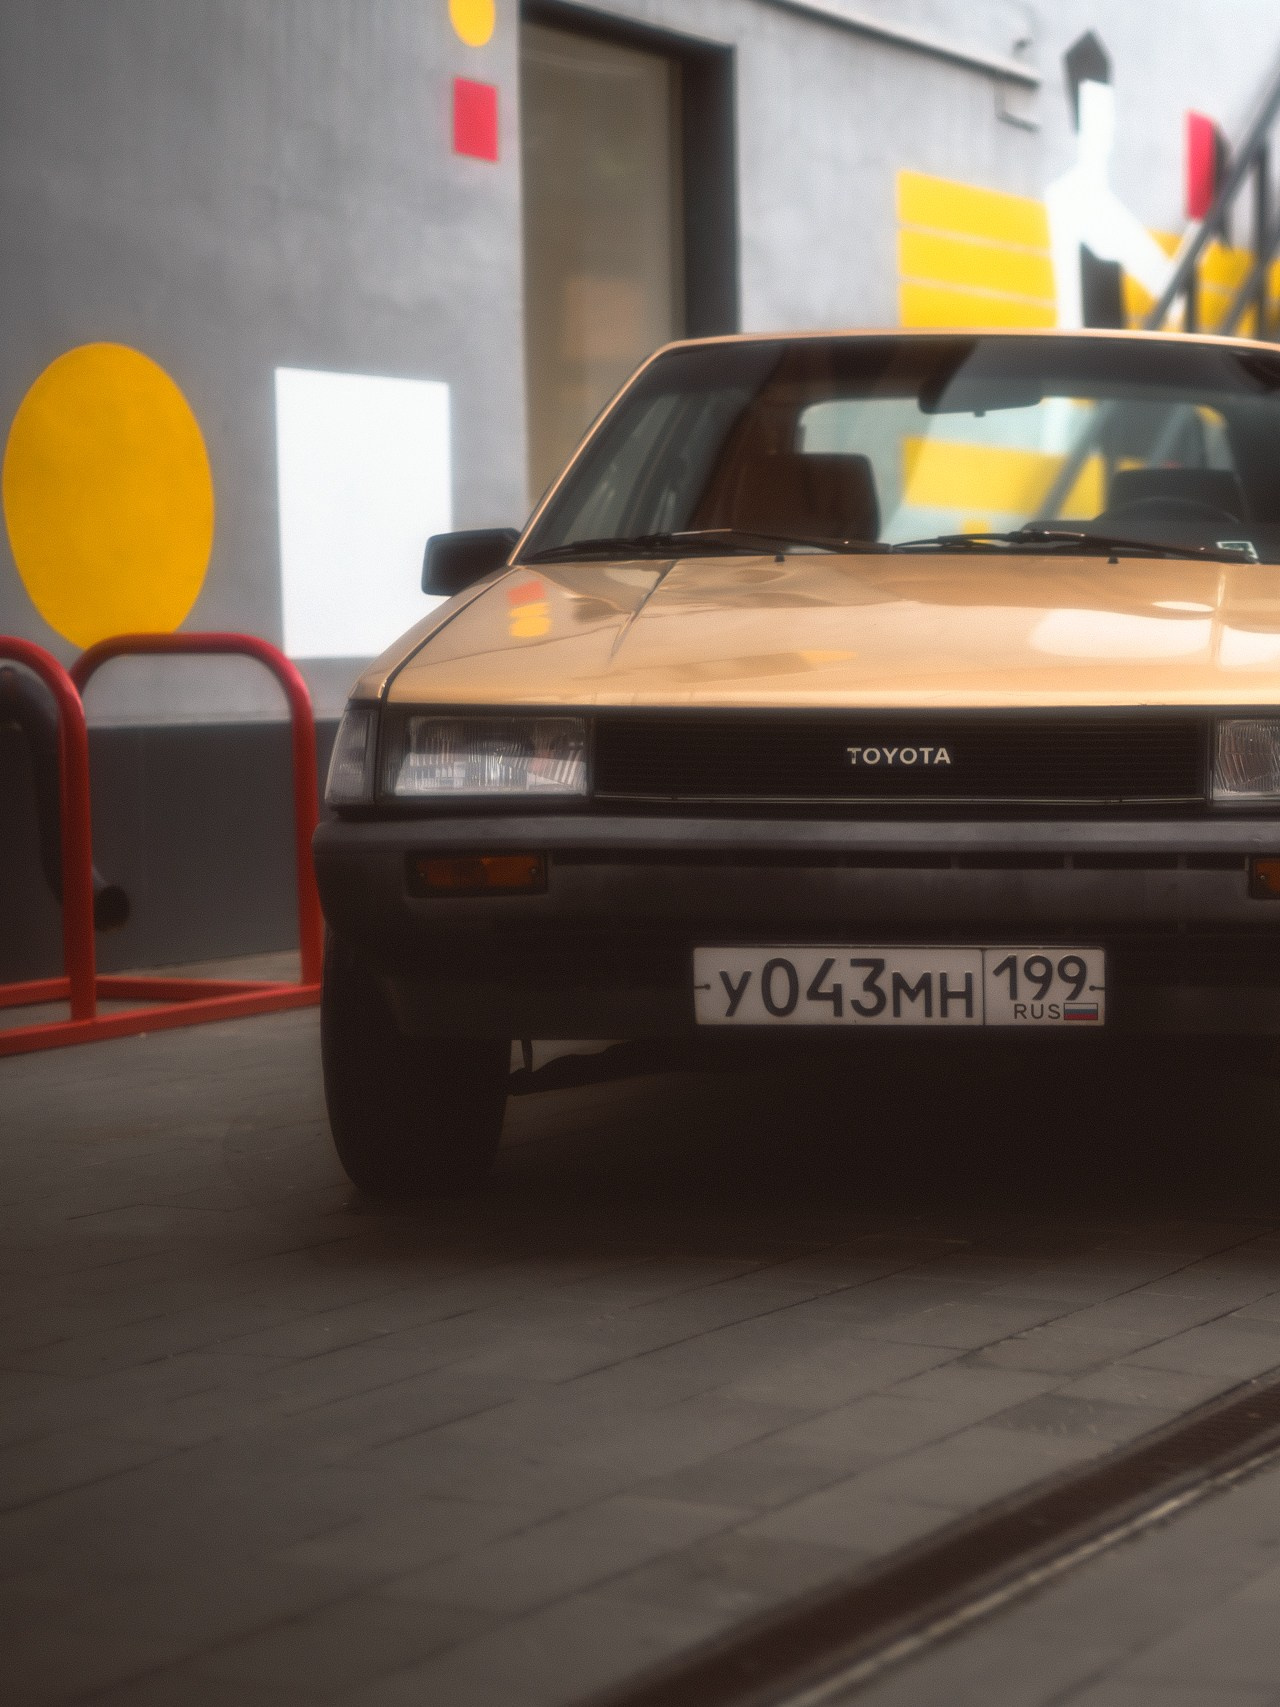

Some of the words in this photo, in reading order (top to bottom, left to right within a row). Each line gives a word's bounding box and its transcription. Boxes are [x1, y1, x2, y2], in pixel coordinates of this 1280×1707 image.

[847, 747, 951, 764] TOYOTA
[993, 954, 1088, 1001] 199
[1014, 1003, 1061, 1019] RUS
